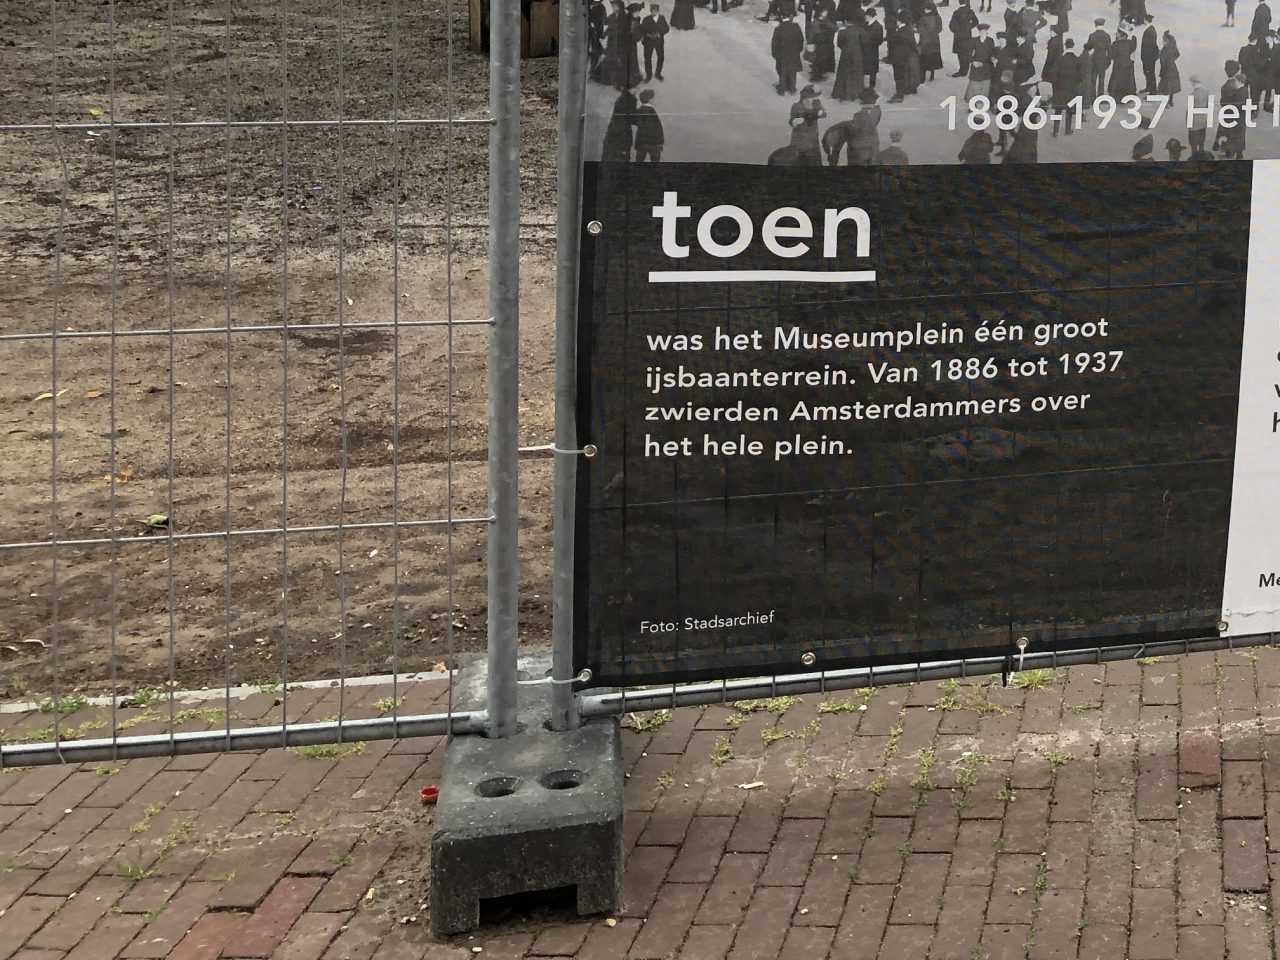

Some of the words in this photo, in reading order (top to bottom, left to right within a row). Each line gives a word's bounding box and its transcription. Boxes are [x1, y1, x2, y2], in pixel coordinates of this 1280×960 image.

[939, 94, 1168, 133] 1886-1937
[1185, 97, 1258, 129] Het
[651, 191, 871, 259] toen
[646, 334, 704, 351] was
[714, 326, 763, 351] het
[774, 321, 964, 353] Museumplein
[974, 319, 1024, 343] één
[1034, 317, 1109, 346] groot
[646, 364, 856, 394] ijsbaanterrein.
[867, 361, 918, 384] Van
[930, 356, 998, 381] 1886
[1007, 356, 1049, 378] tot
[1058, 350, 1124, 375] 1937
[644, 400, 779, 422] zwierden
[788, 395, 1021, 421] Amsterdammers
[1031, 393, 1091, 412] over
[644, 433, 693, 457] het
[703, 433, 764, 456] hele
[774, 433, 853, 461] plein.
[640, 620, 679, 634] Foto:
[684, 609, 775, 631] Stadsarchief
